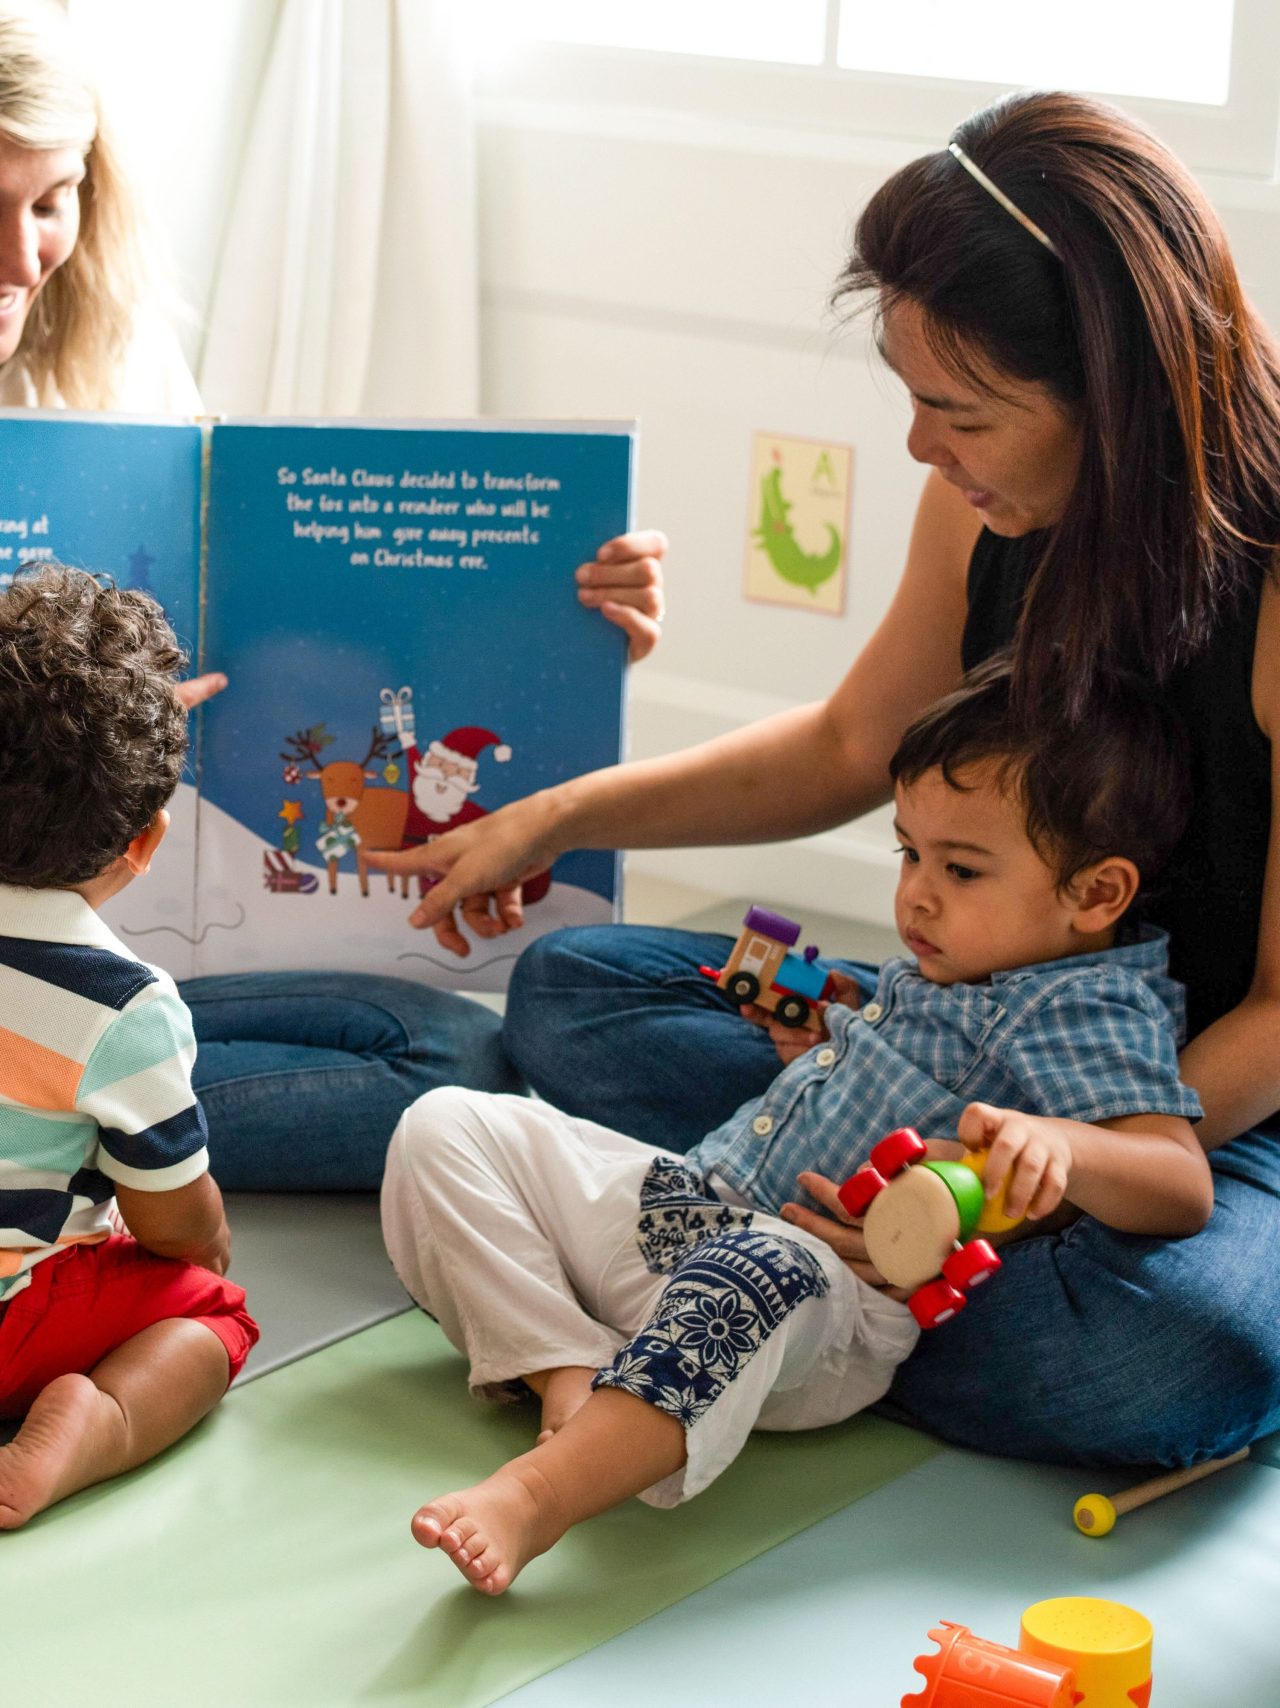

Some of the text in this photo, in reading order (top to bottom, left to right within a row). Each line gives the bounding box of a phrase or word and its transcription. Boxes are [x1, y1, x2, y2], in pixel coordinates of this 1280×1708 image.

[277, 468, 560, 492] So Santa Claus decided to transform
[811, 450, 836, 486] A
[287, 494, 550, 518] the fox into a reindeer who will be
[32, 515, 49, 535] at
[294, 521, 539, 548] helping him give away presents
[350, 549, 488, 571] on Christmas eve.
